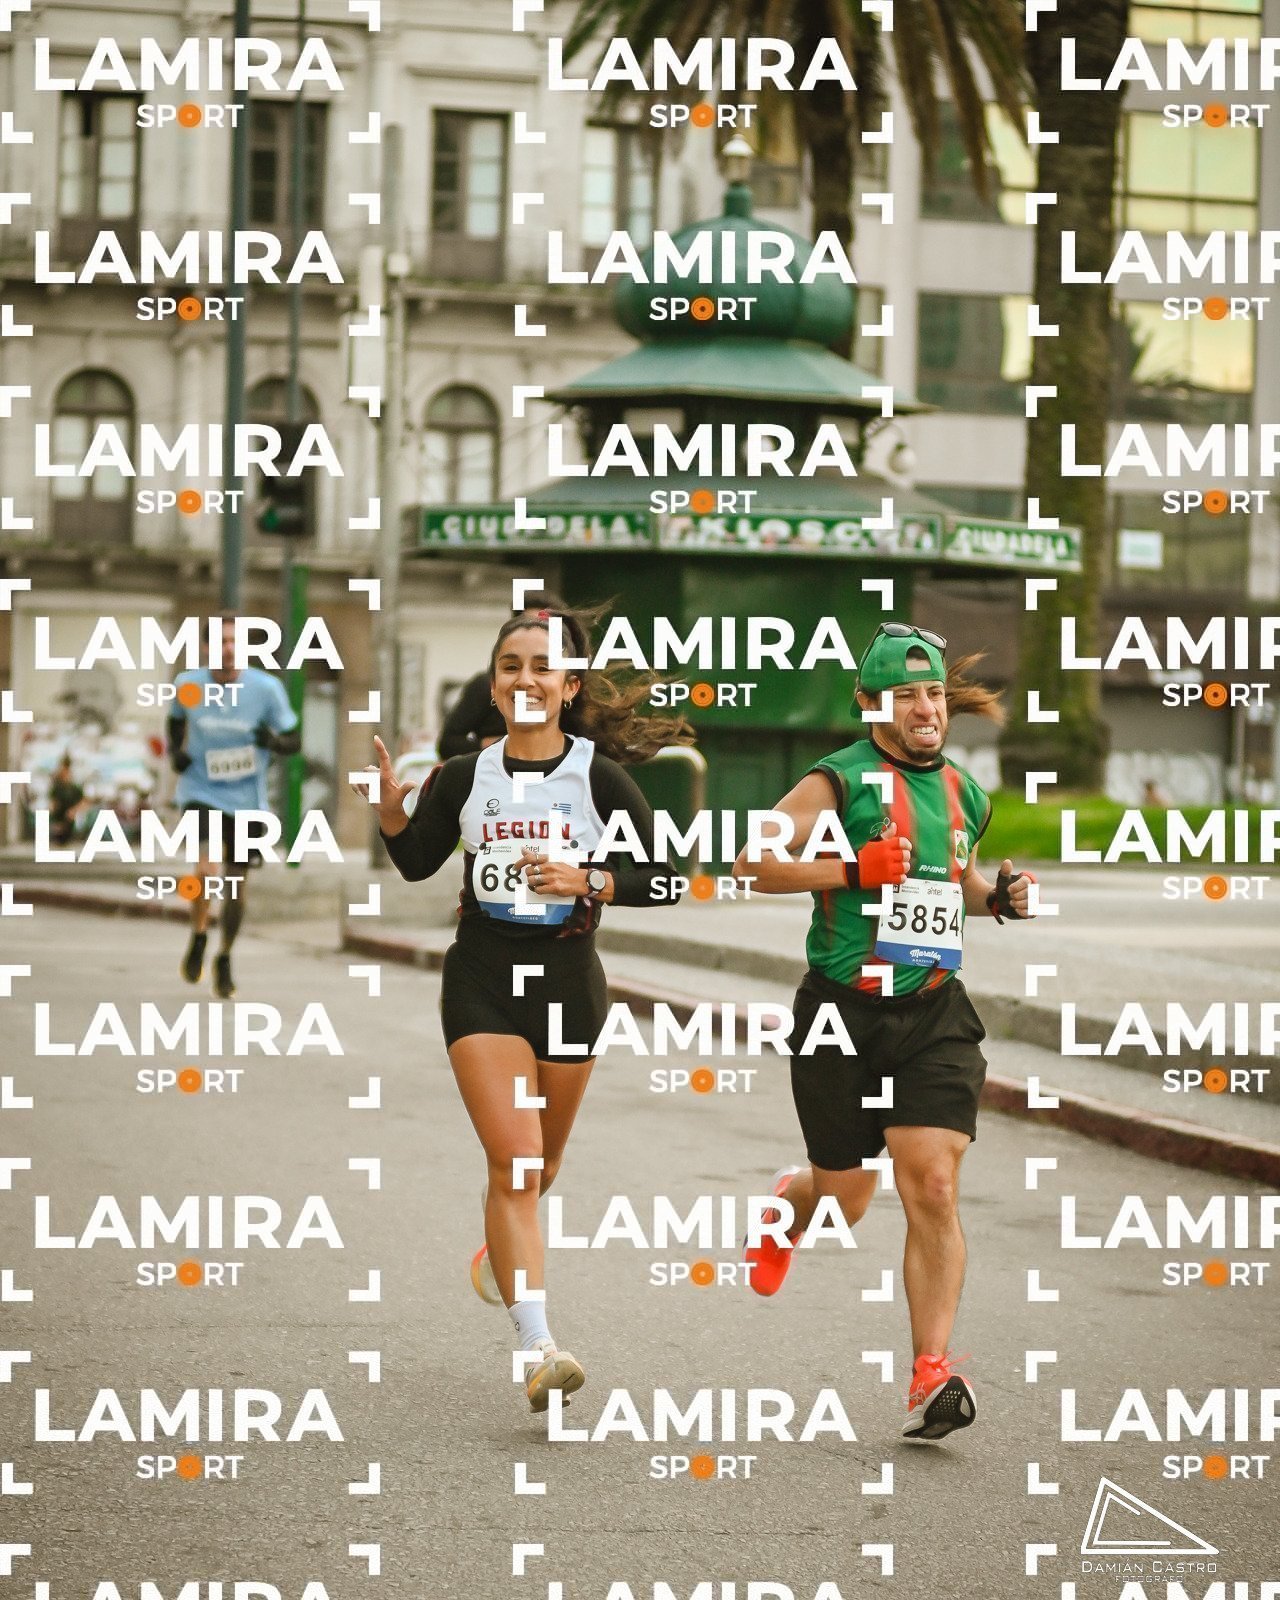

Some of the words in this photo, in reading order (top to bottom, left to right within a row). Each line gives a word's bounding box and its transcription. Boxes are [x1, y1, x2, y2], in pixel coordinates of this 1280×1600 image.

[442, 515, 630, 538] CIUDDELA
[919, 864, 947, 874] RHINO
[887, 902, 960, 937] 5854
